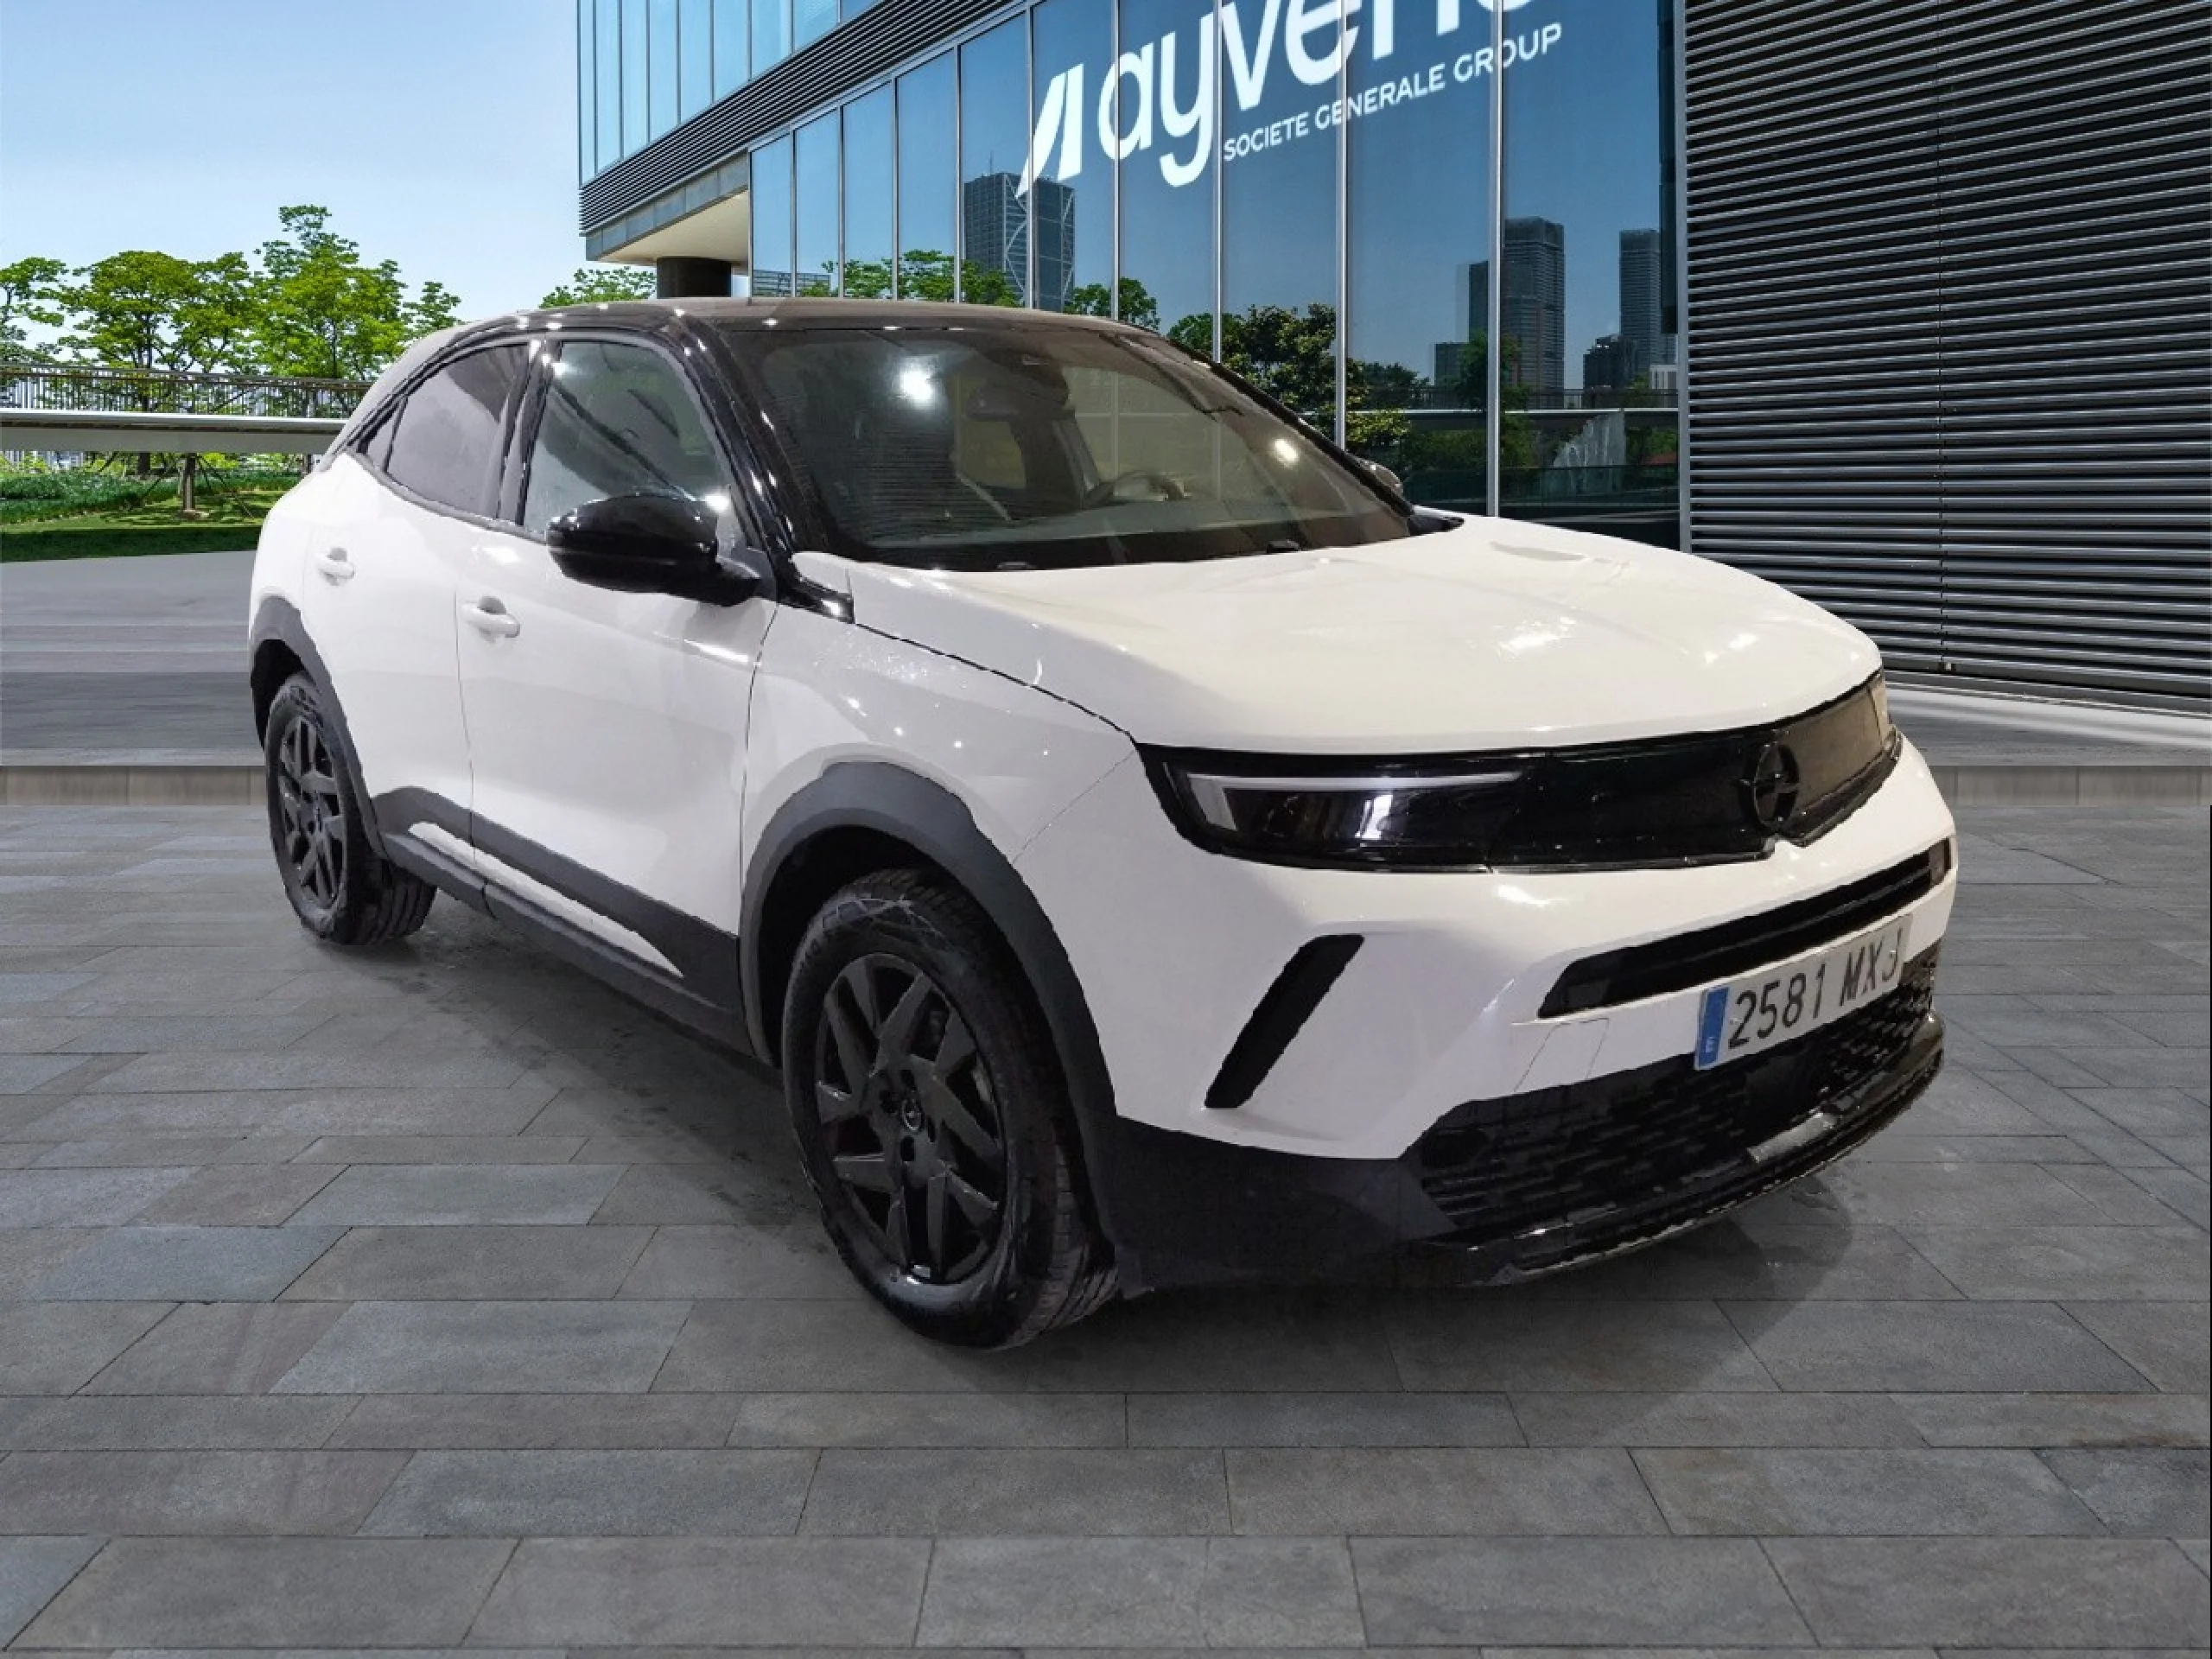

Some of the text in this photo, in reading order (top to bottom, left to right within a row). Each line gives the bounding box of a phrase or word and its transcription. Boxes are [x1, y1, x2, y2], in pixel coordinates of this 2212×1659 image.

[1098, 0, 1533, 187] ayve
[1224, 22, 1561, 162] SOCIETE GENERALE GROUP
[1729, 926, 1903, 1049] 2581 MXJ
